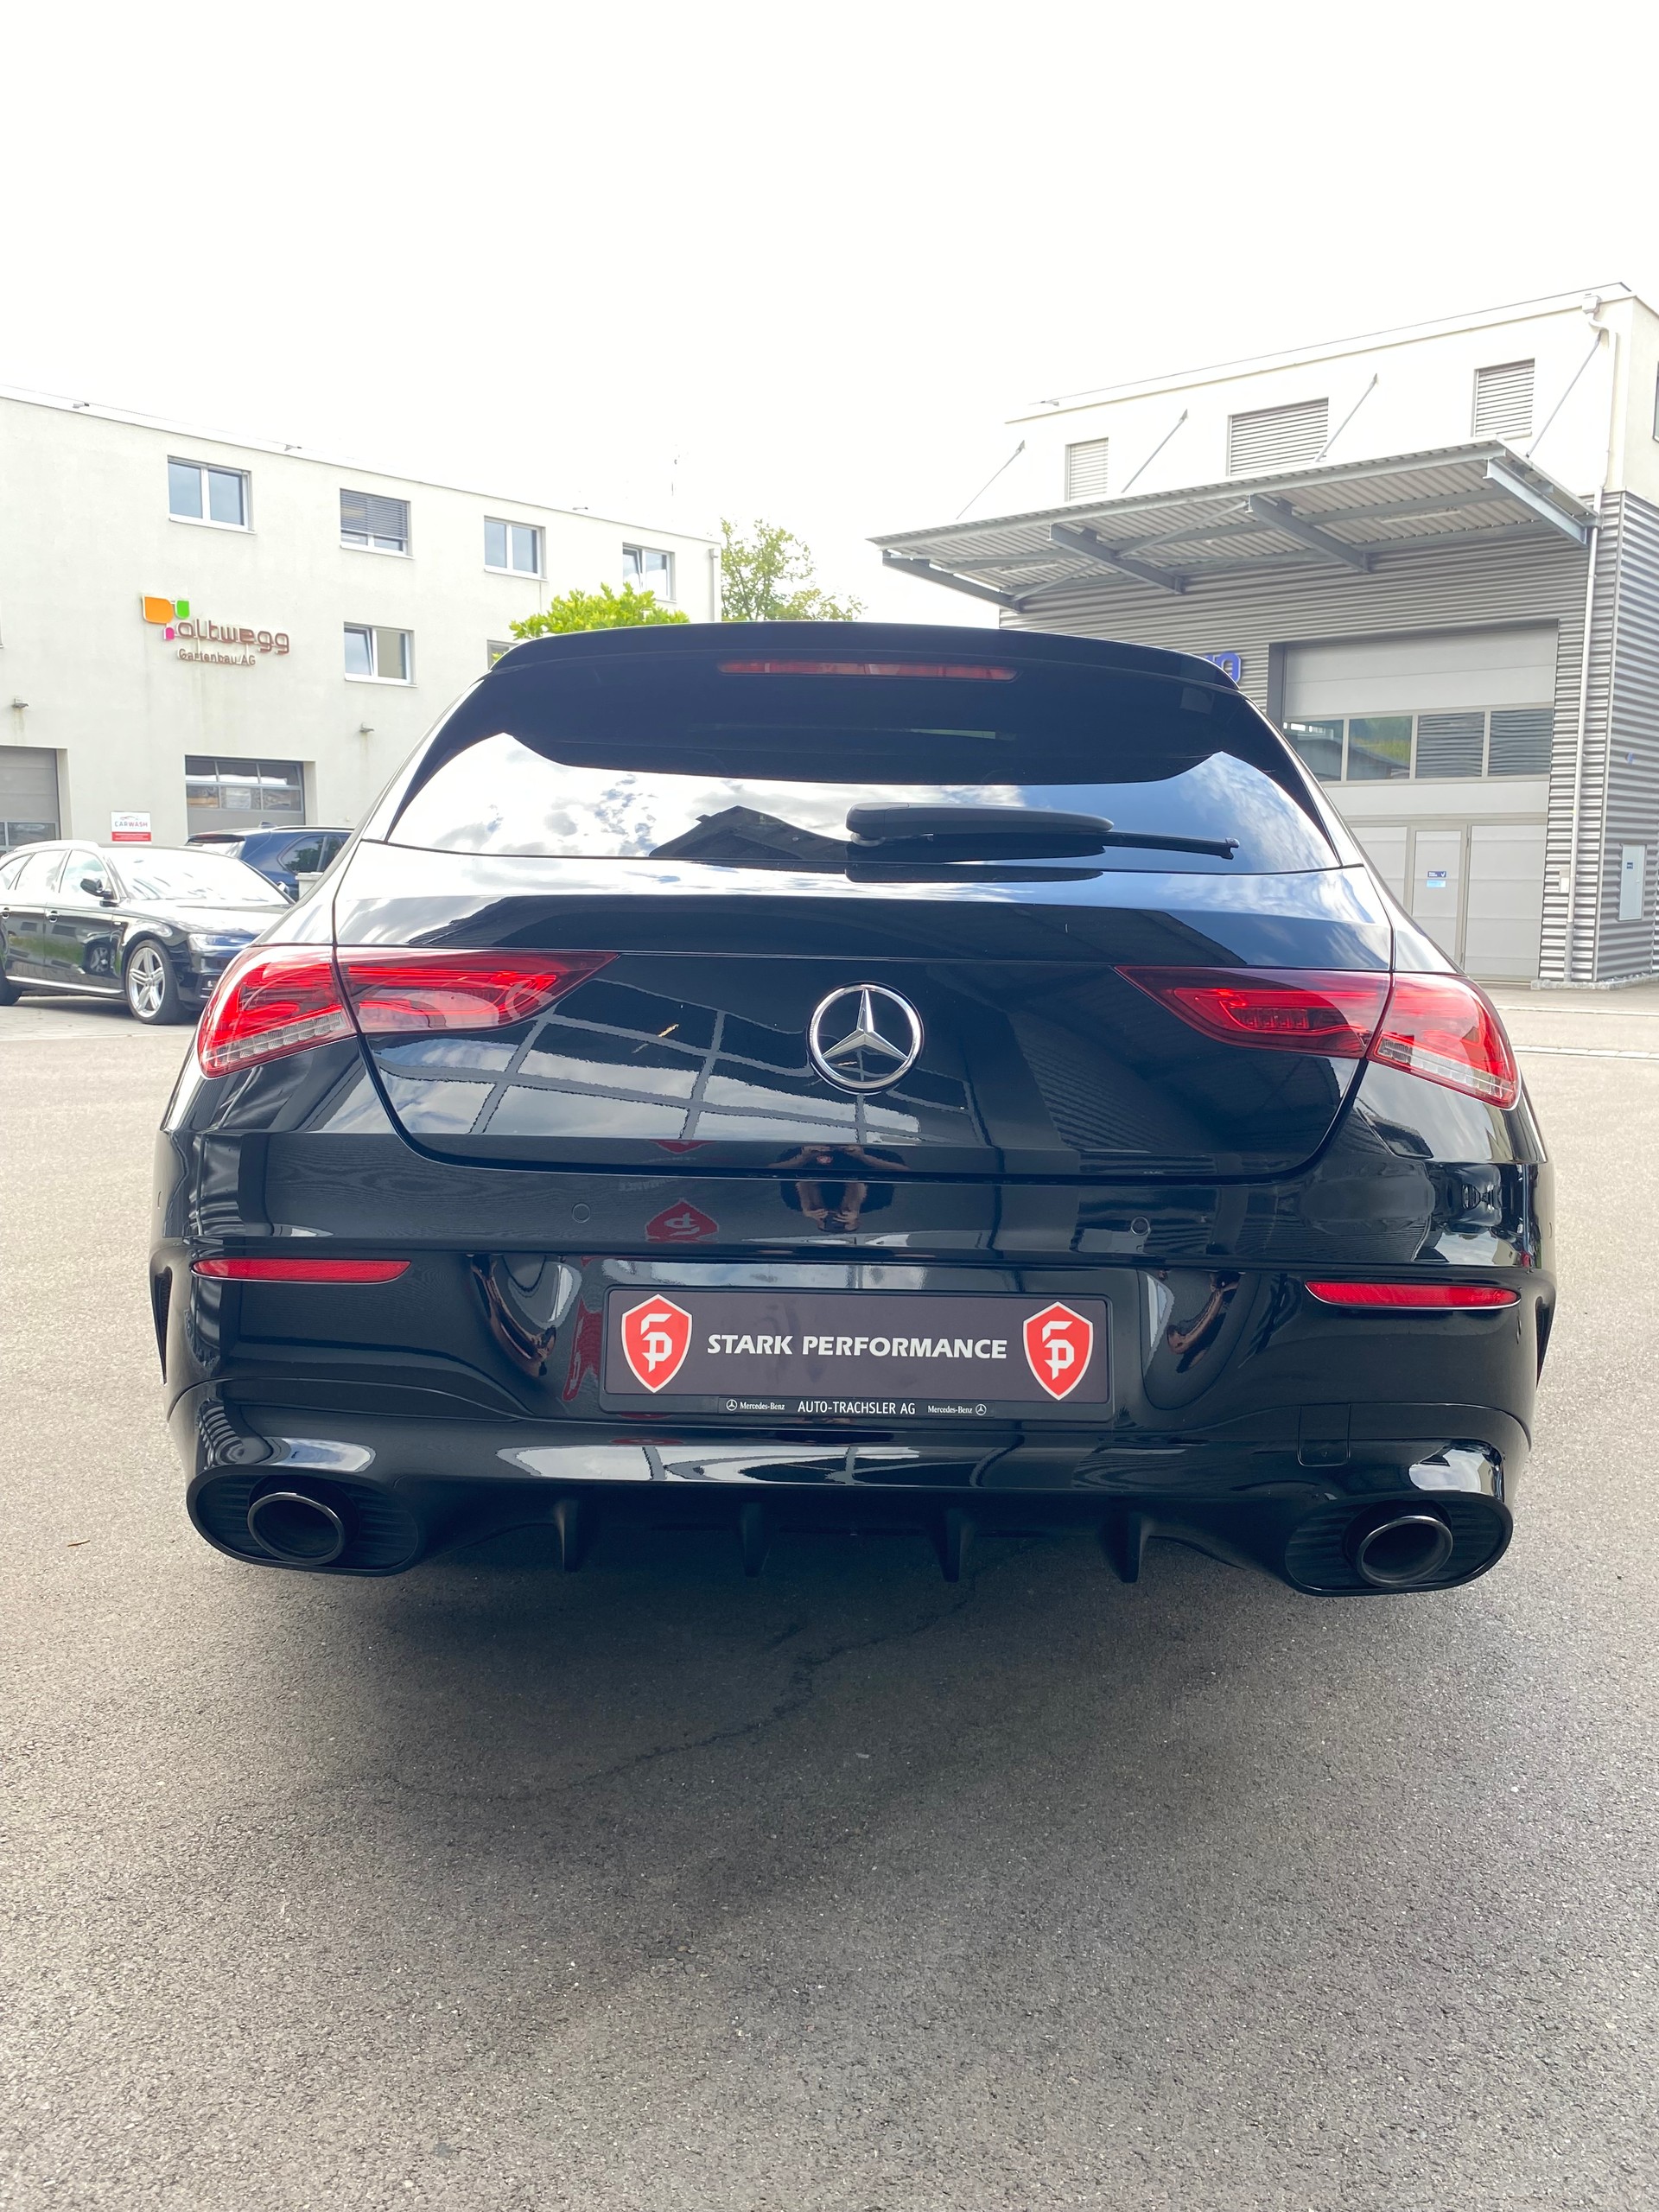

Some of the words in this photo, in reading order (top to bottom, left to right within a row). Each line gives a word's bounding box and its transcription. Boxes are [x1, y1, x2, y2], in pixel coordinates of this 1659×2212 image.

[176, 619, 290, 655] altwegg
[178, 648, 238, 664] Gartenbau
[240, 654, 257, 666] AG
[707, 1334, 793, 1355] STARK
[803, 1336, 1008, 1359] PERFORMANCE
[740, 1401, 785, 1410] Mercedes-Benz
[798, 1401, 896, 1414] AUTO-TRACHSLER
[900, 1402, 916, 1414] AG
[927, 1404, 973, 1414] Mercedes-Benz
